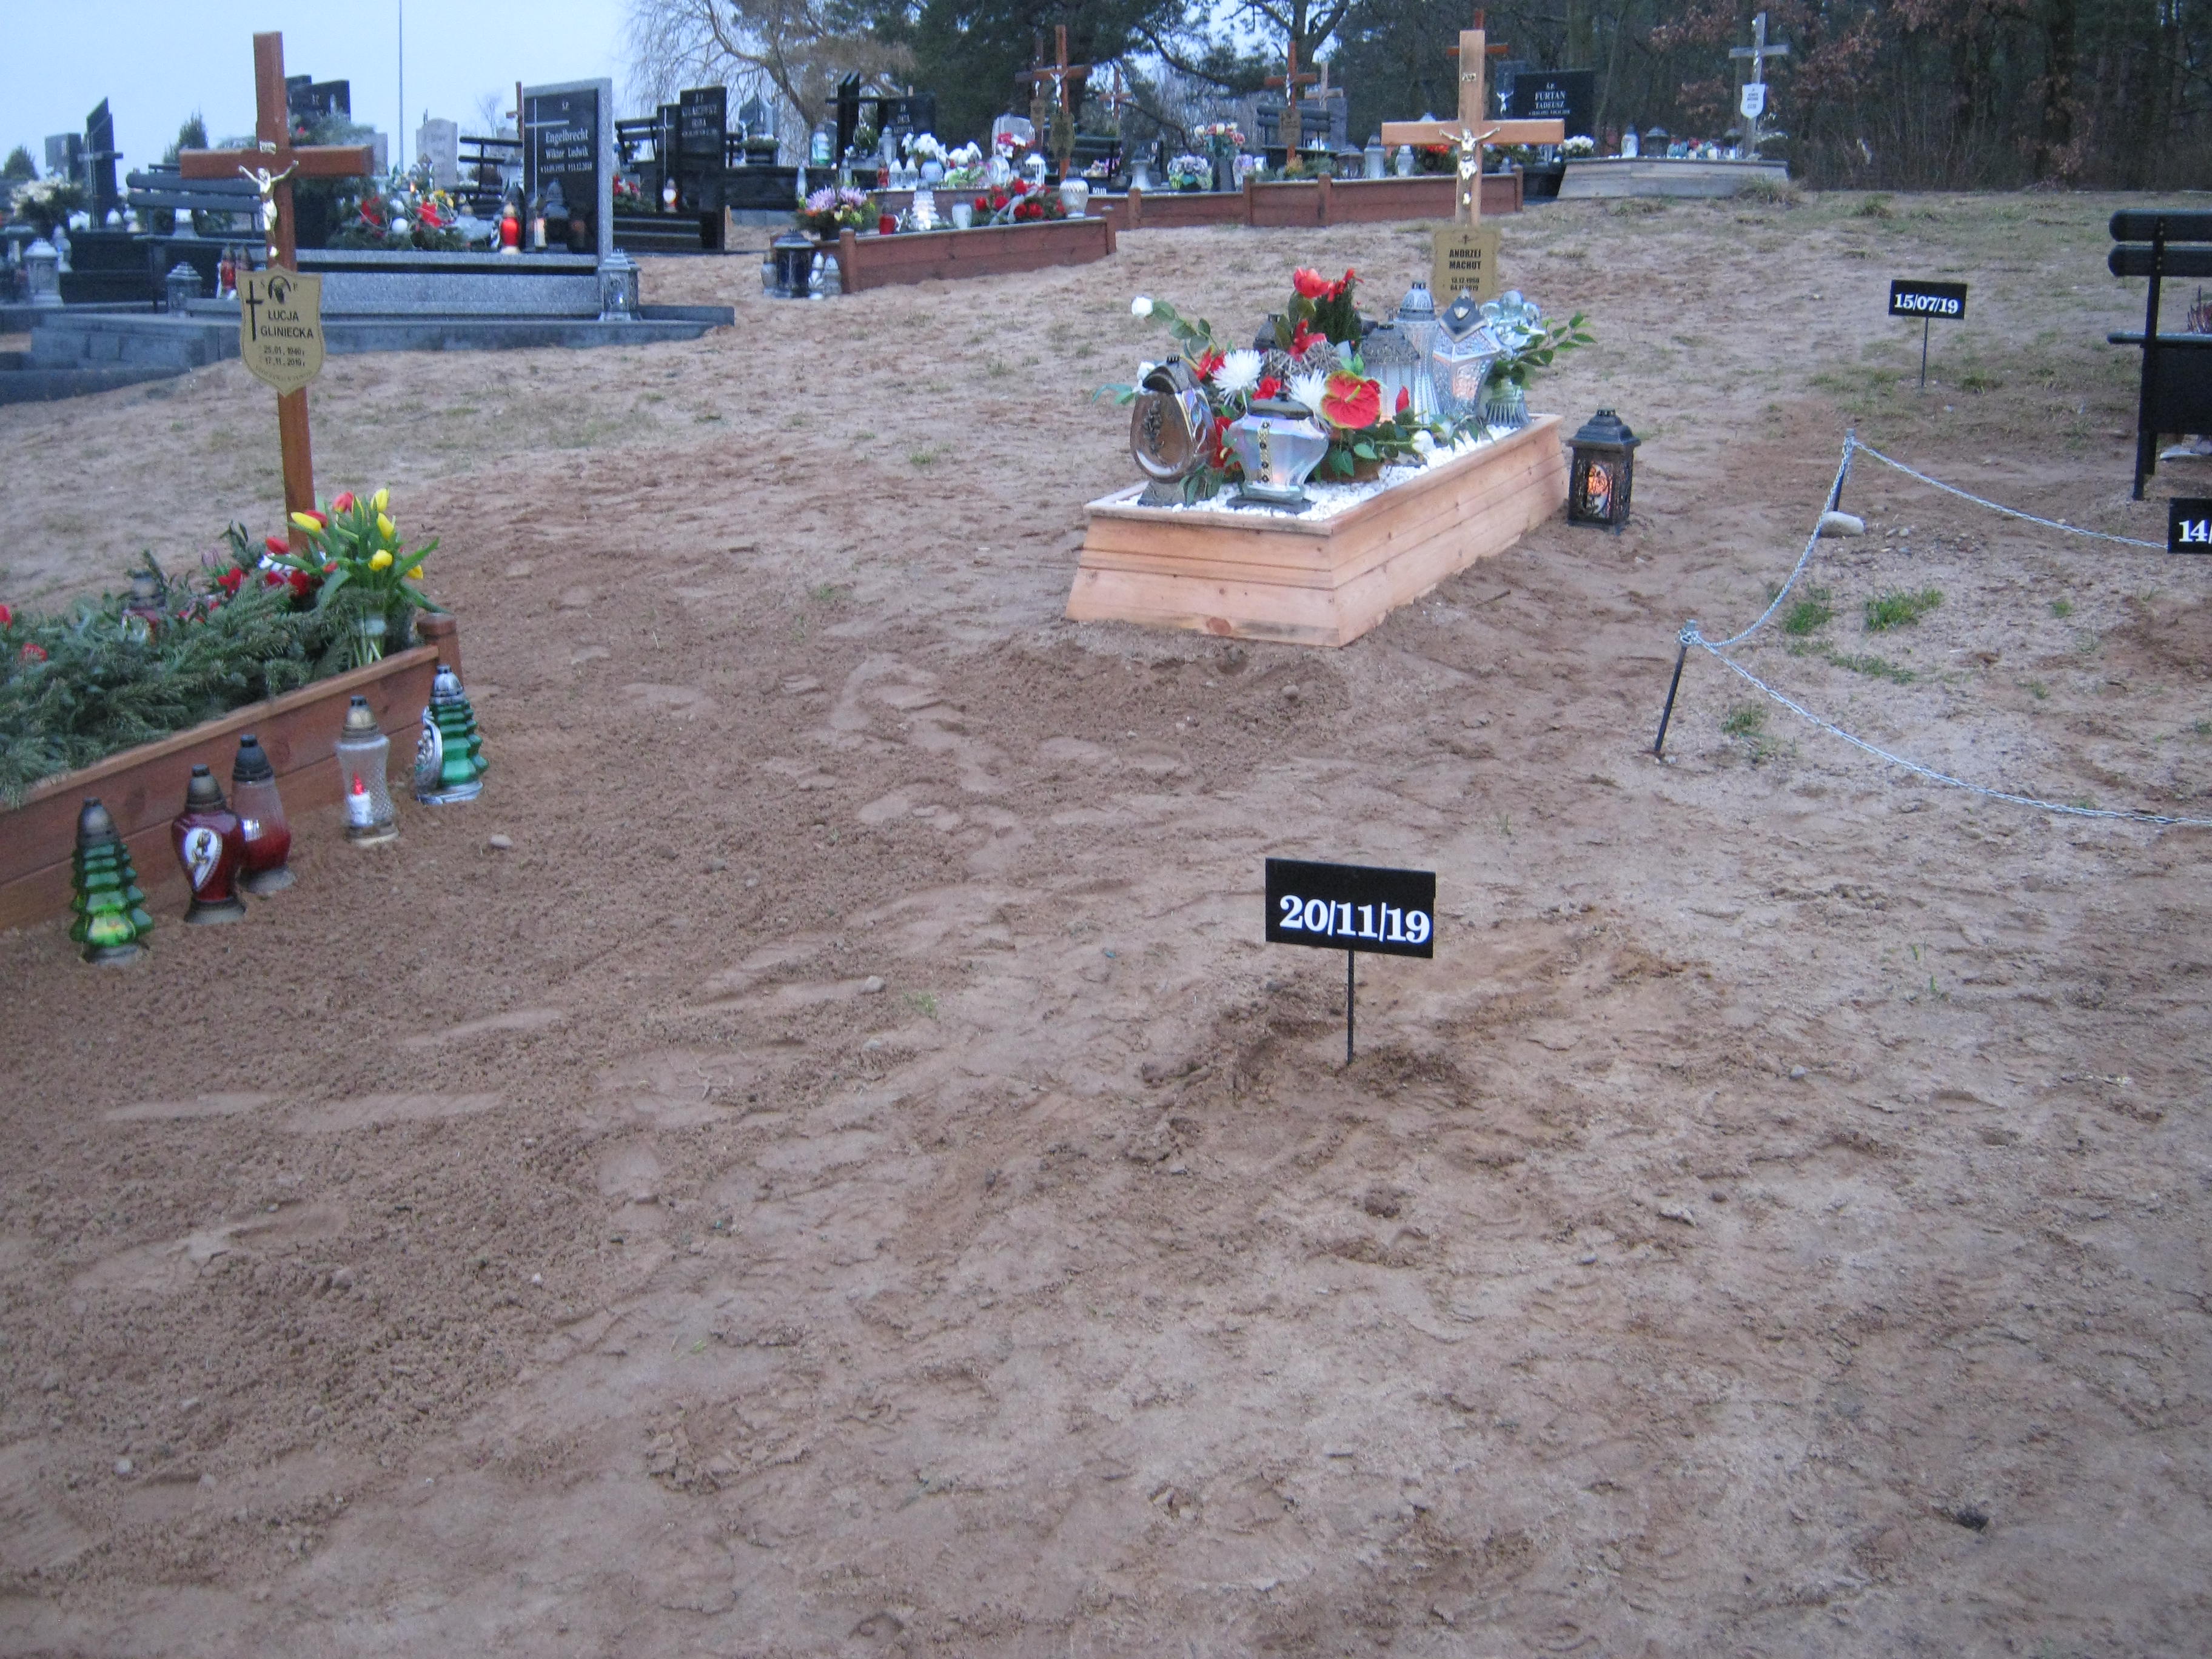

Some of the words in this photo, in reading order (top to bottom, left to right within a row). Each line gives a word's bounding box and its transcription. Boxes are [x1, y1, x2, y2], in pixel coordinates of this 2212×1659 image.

[1535, 101, 1564, 109] TADEUSZ
[546, 127, 588, 146] Engelbrecht
[546, 148, 565, 159] Wiktor
[568, 146, 588, 158] Ludwik
[1449, 249, 1481, 258] ANDRZEJ
[1894, 293, 1959, 315] 15/07/19
[260, 325, 314, 340] GLINIECKA
[1279, 894, 1430, 944] 20/11/19
